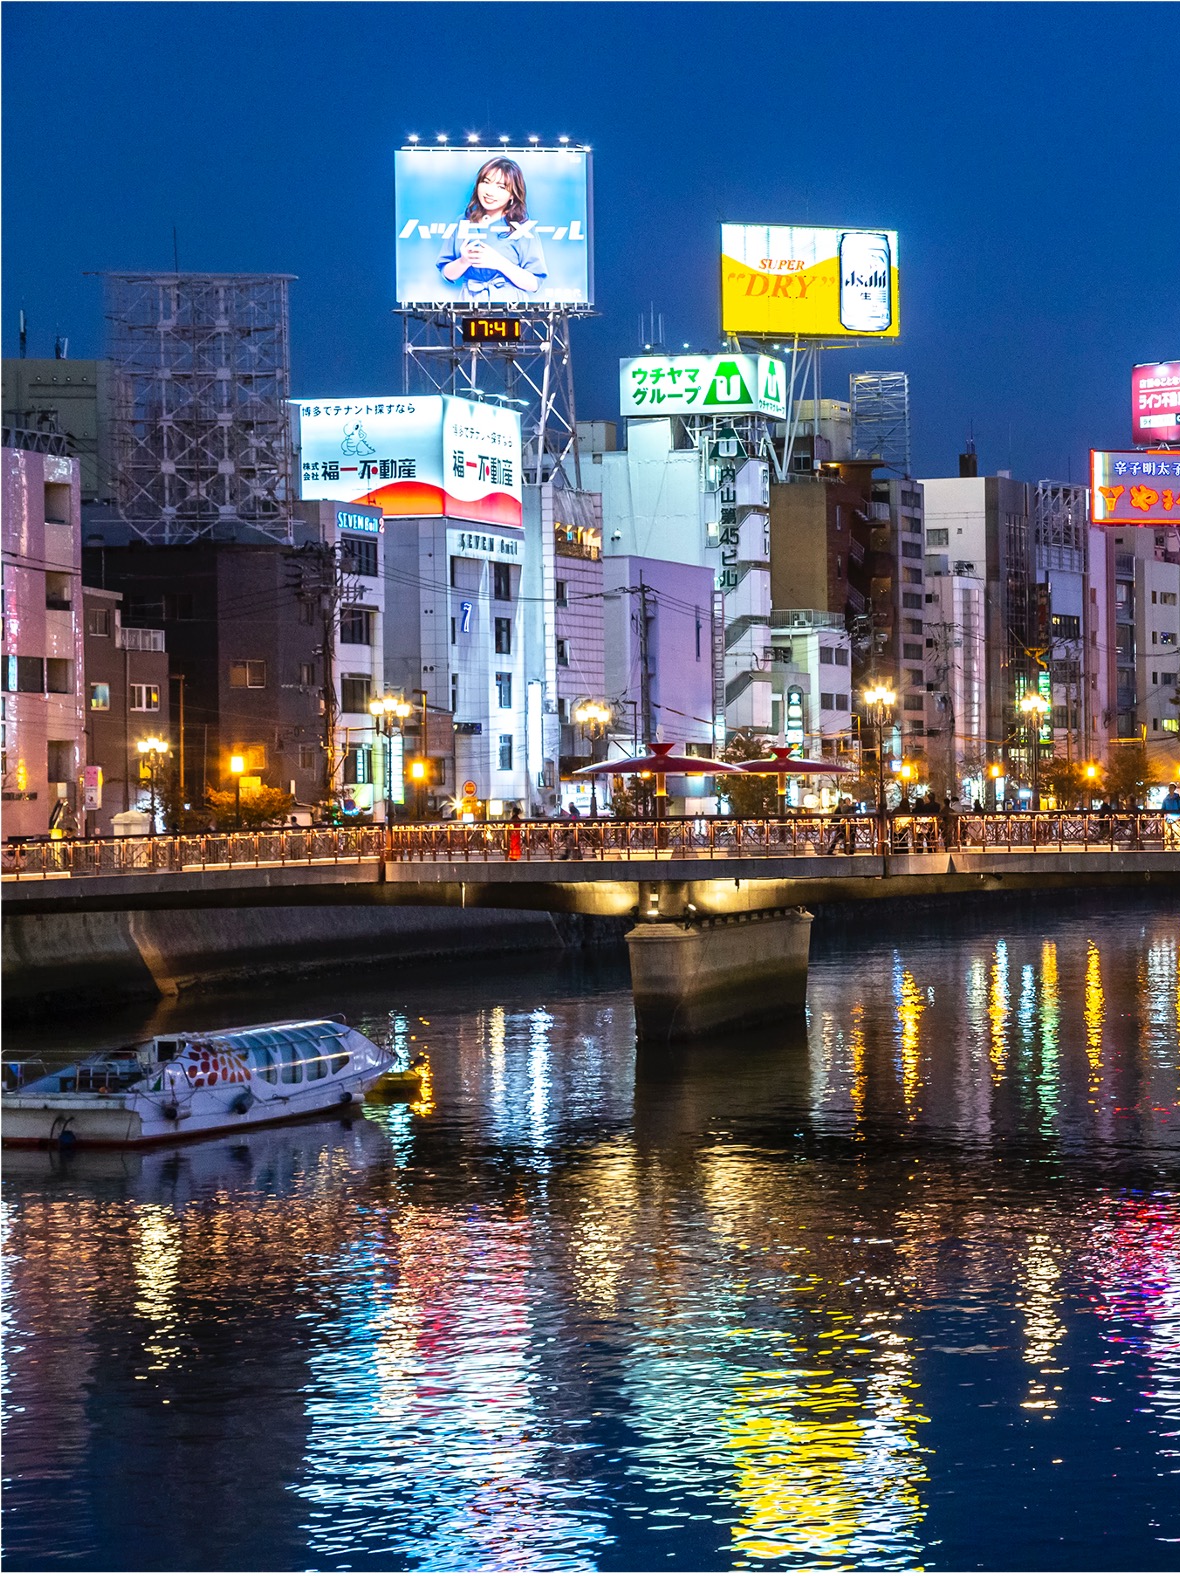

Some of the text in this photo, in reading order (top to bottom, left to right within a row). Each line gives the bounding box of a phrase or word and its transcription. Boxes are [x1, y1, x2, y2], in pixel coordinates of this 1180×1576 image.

[398, 214, 585, 241] ハッピーメール
[758, 258, 806, 271] SUPER
[844, 269, 888, 289] Asahi
[470, 320, 521, 338] 17:41
[631, 366, 700, 386] ウチヤマ
[631, 386, 702, 406] グループ
[302, 461, 320, 471] 株式
[321, 458, 417, 481] 福一不動産
[452, 448, 514, 487] 福一不動産
[302, 472, 320, 481] 会社
[337, 511, 364, 530] SEVEN
[379, 517, 385, 534] 2
[719, 468, 740, 588] 内山第45ビル
[458, 532, 495, 551] SEVEN
[461, 601, 472, 633] 7
